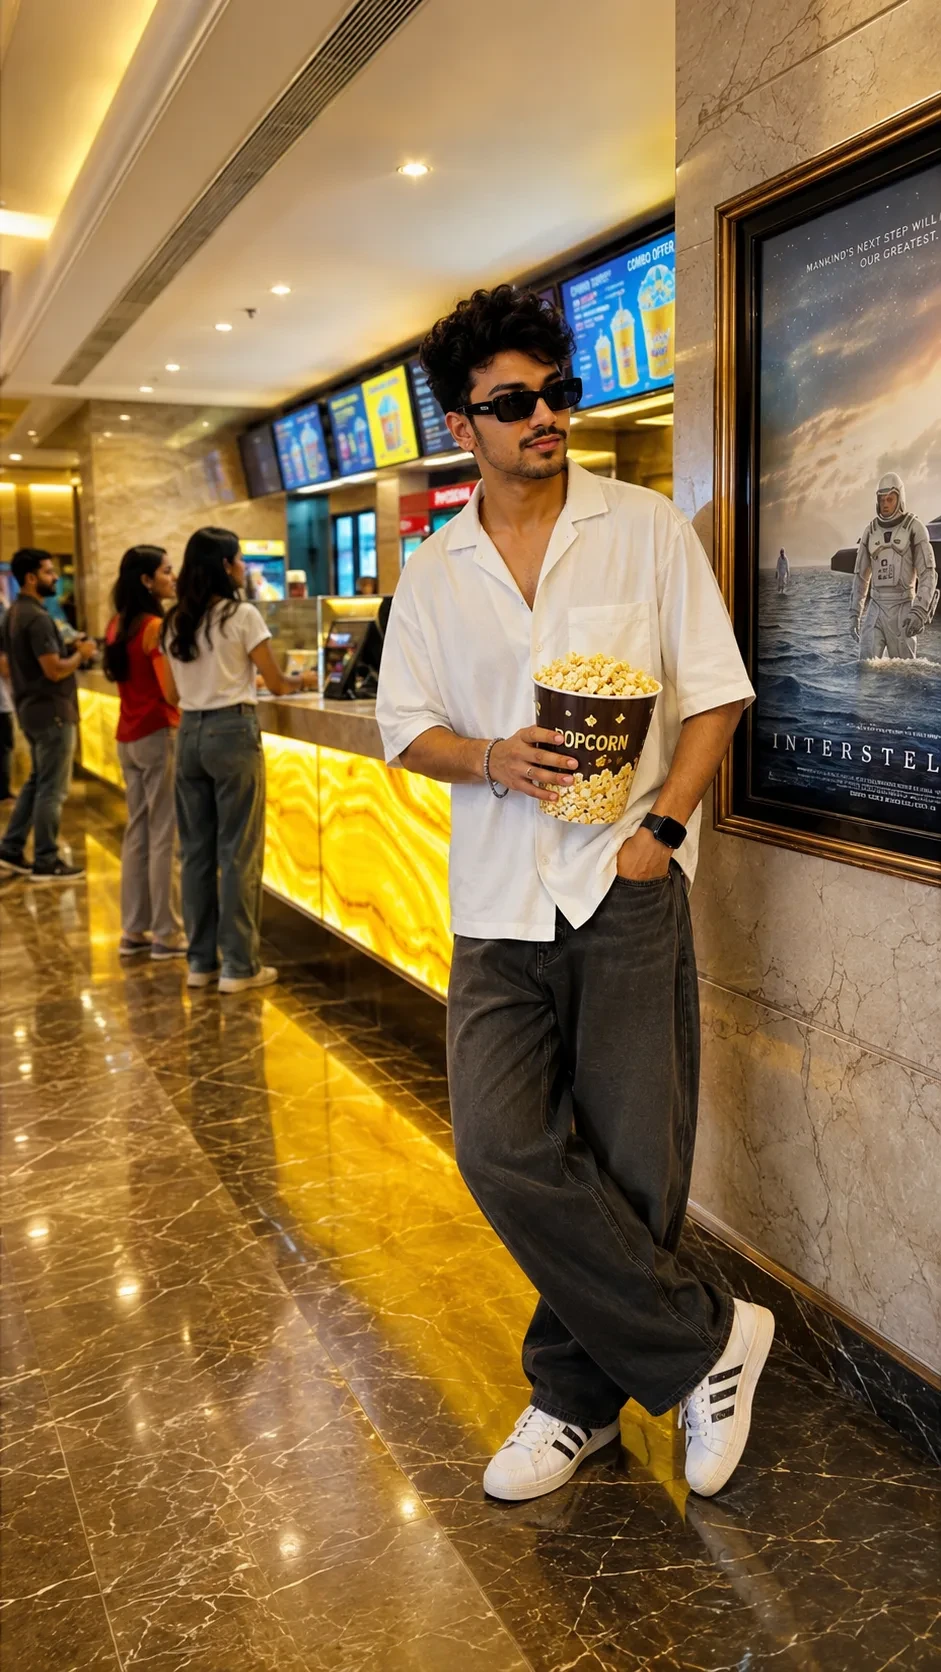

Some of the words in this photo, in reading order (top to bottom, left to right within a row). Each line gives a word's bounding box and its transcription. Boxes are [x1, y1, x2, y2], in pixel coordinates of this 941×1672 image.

[626, 252, 651, 272] COMBO
[806, 247, 854, 273] MANKIND'S
[857, 236, 880, 254] NEXT
[883, 225, 908, 243] STEP
[911, 214, 937, 231] WILL
[860, 252, 880, 268] OUR
[883, 230, 939, 259] GREATEST.
[772, 733, 940, 773] INTERSTEL
